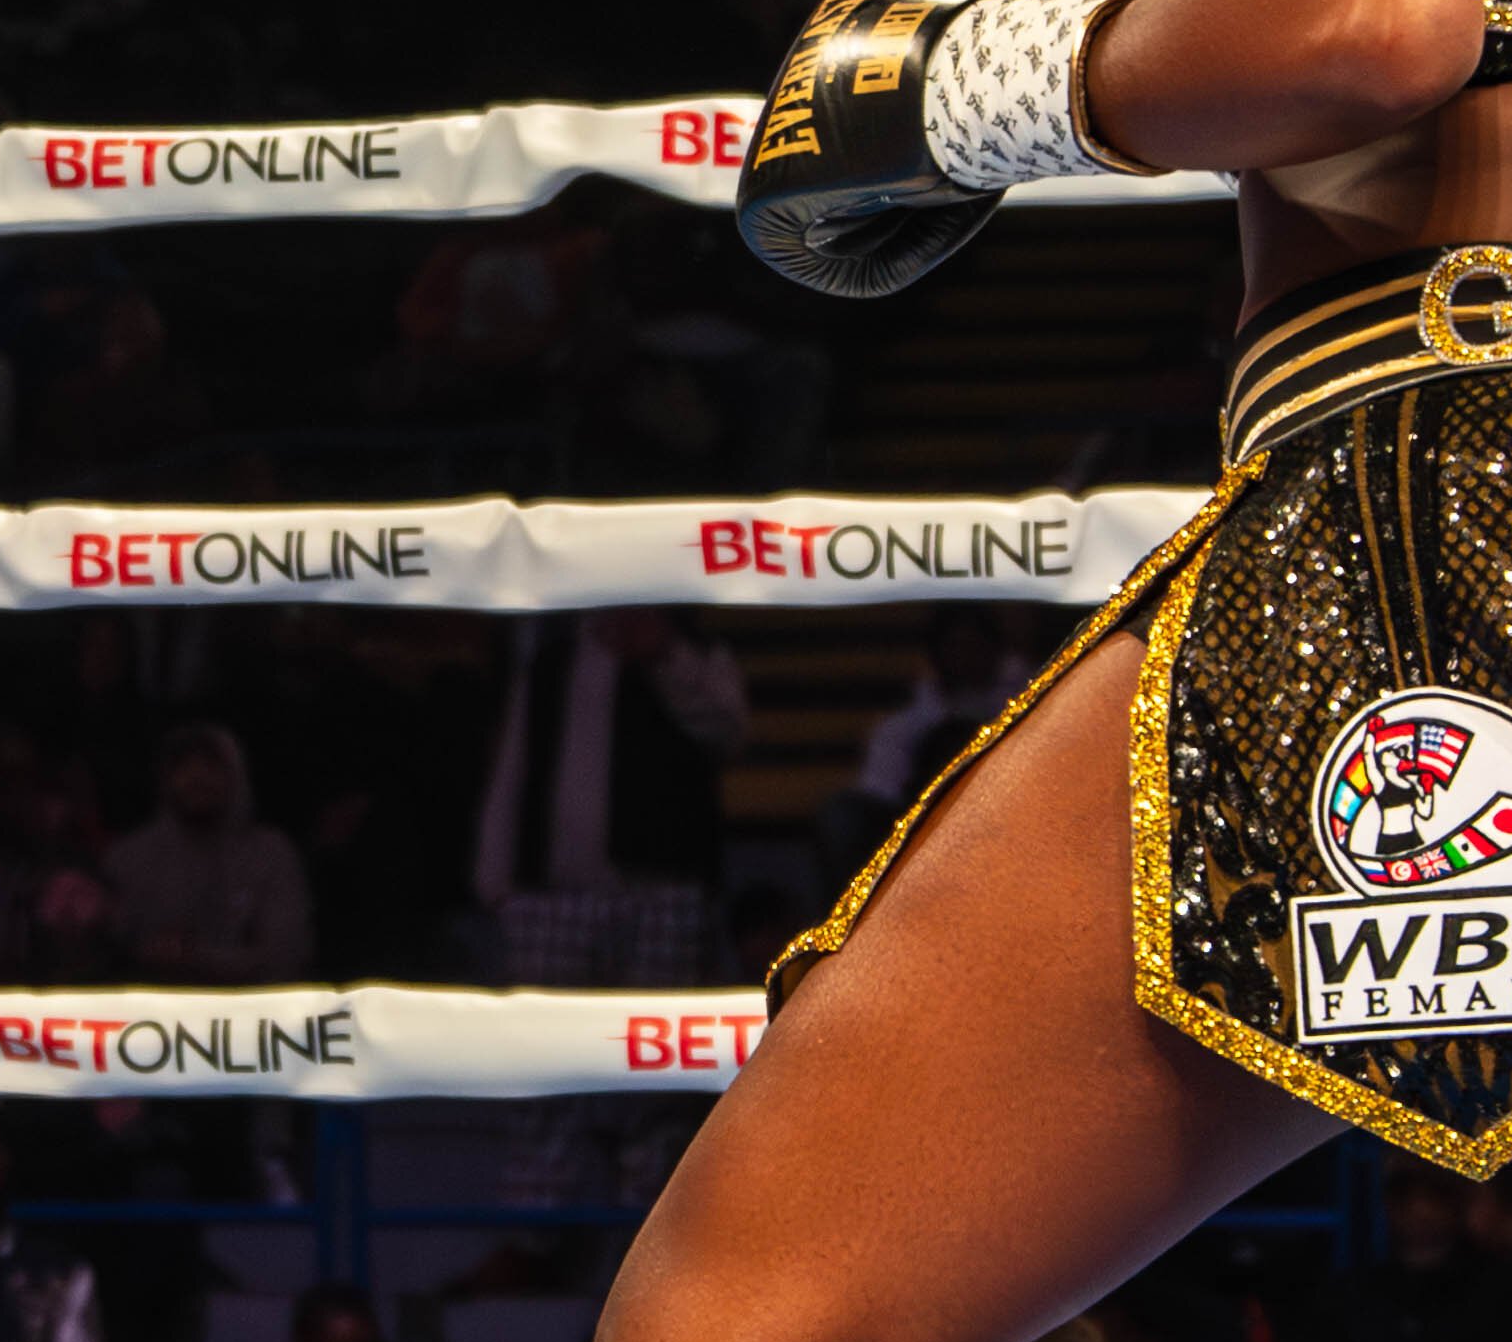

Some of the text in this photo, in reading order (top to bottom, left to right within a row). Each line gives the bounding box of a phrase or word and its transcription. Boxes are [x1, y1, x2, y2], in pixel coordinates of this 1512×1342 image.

[30, 125, 401, 190] BETONLINE
[56, 526, 431, 588] BETONLINE
[686, 519, 1074, 580] BETONLINE
